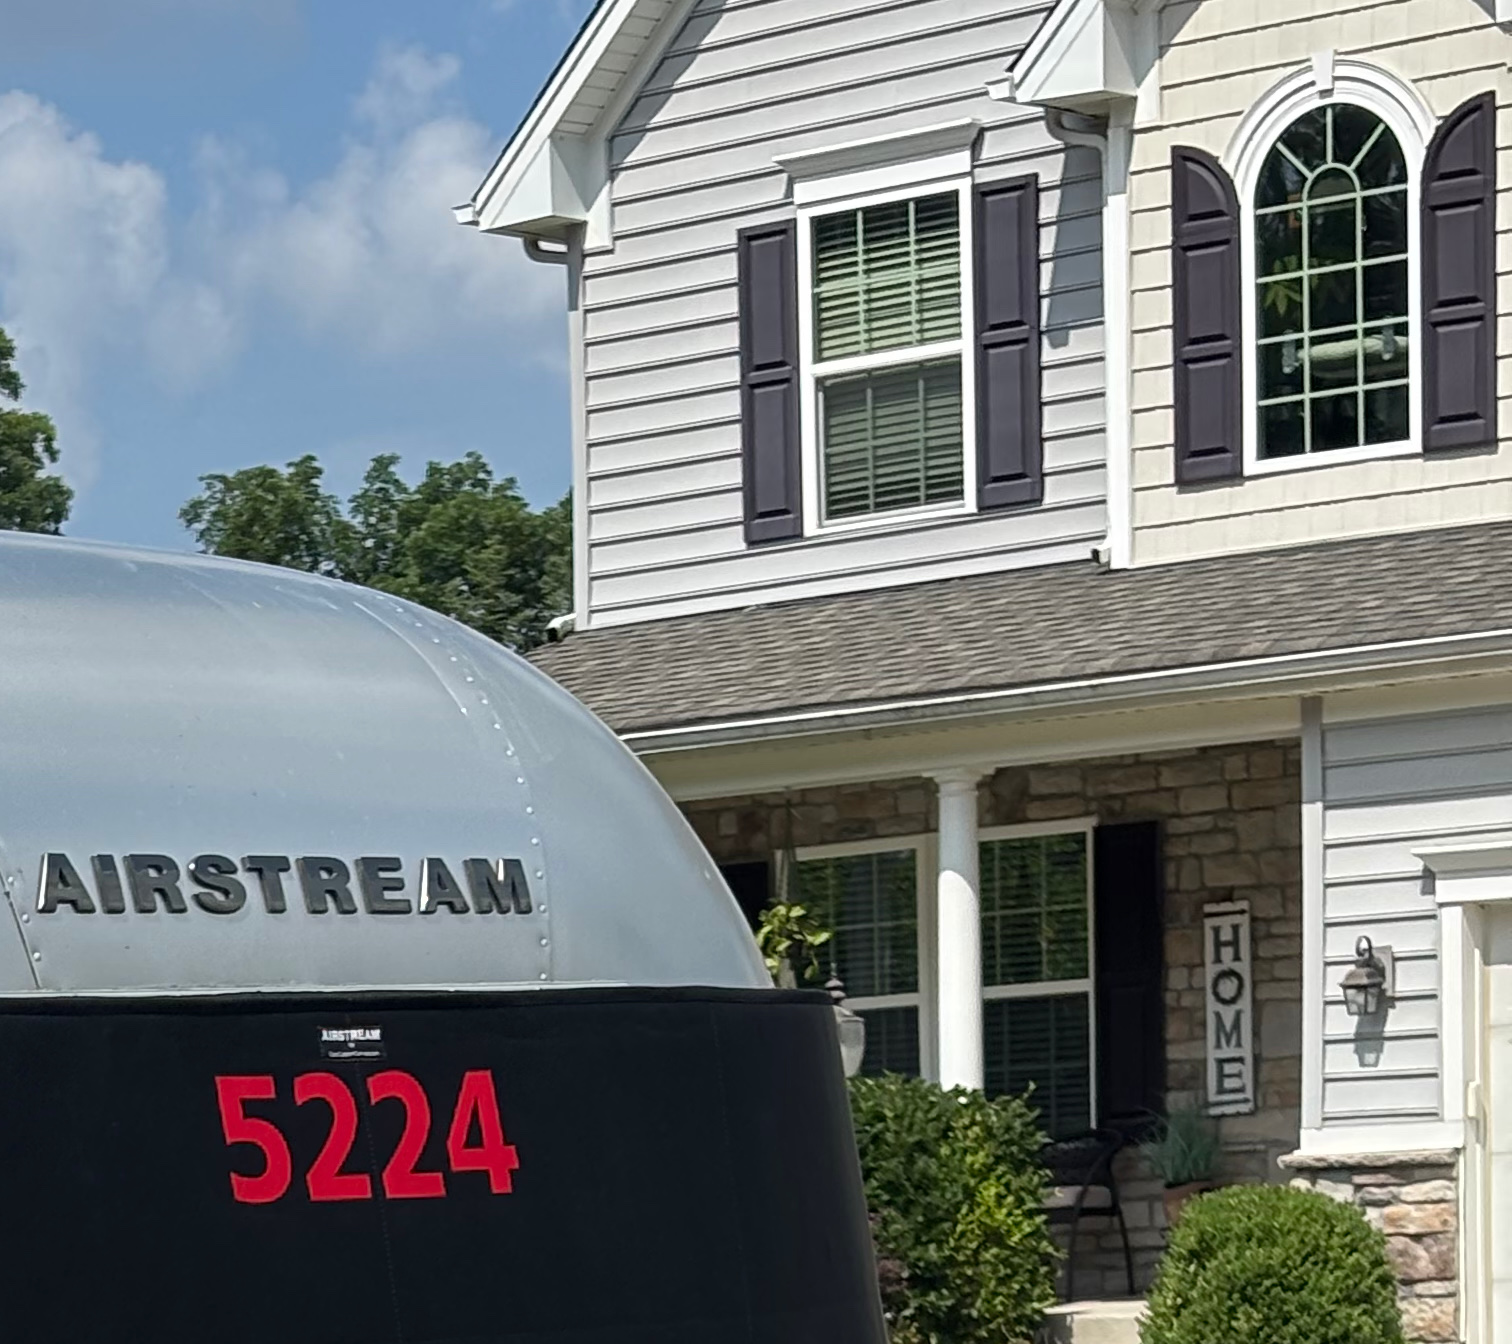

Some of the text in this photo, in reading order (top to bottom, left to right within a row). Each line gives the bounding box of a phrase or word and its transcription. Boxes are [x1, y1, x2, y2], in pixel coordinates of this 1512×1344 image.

[37, 852, 534, 916] AIRSTREAM
[1209, 922, 1247, 1096] HOME
[214, 1069, 520, 1204] 5224
